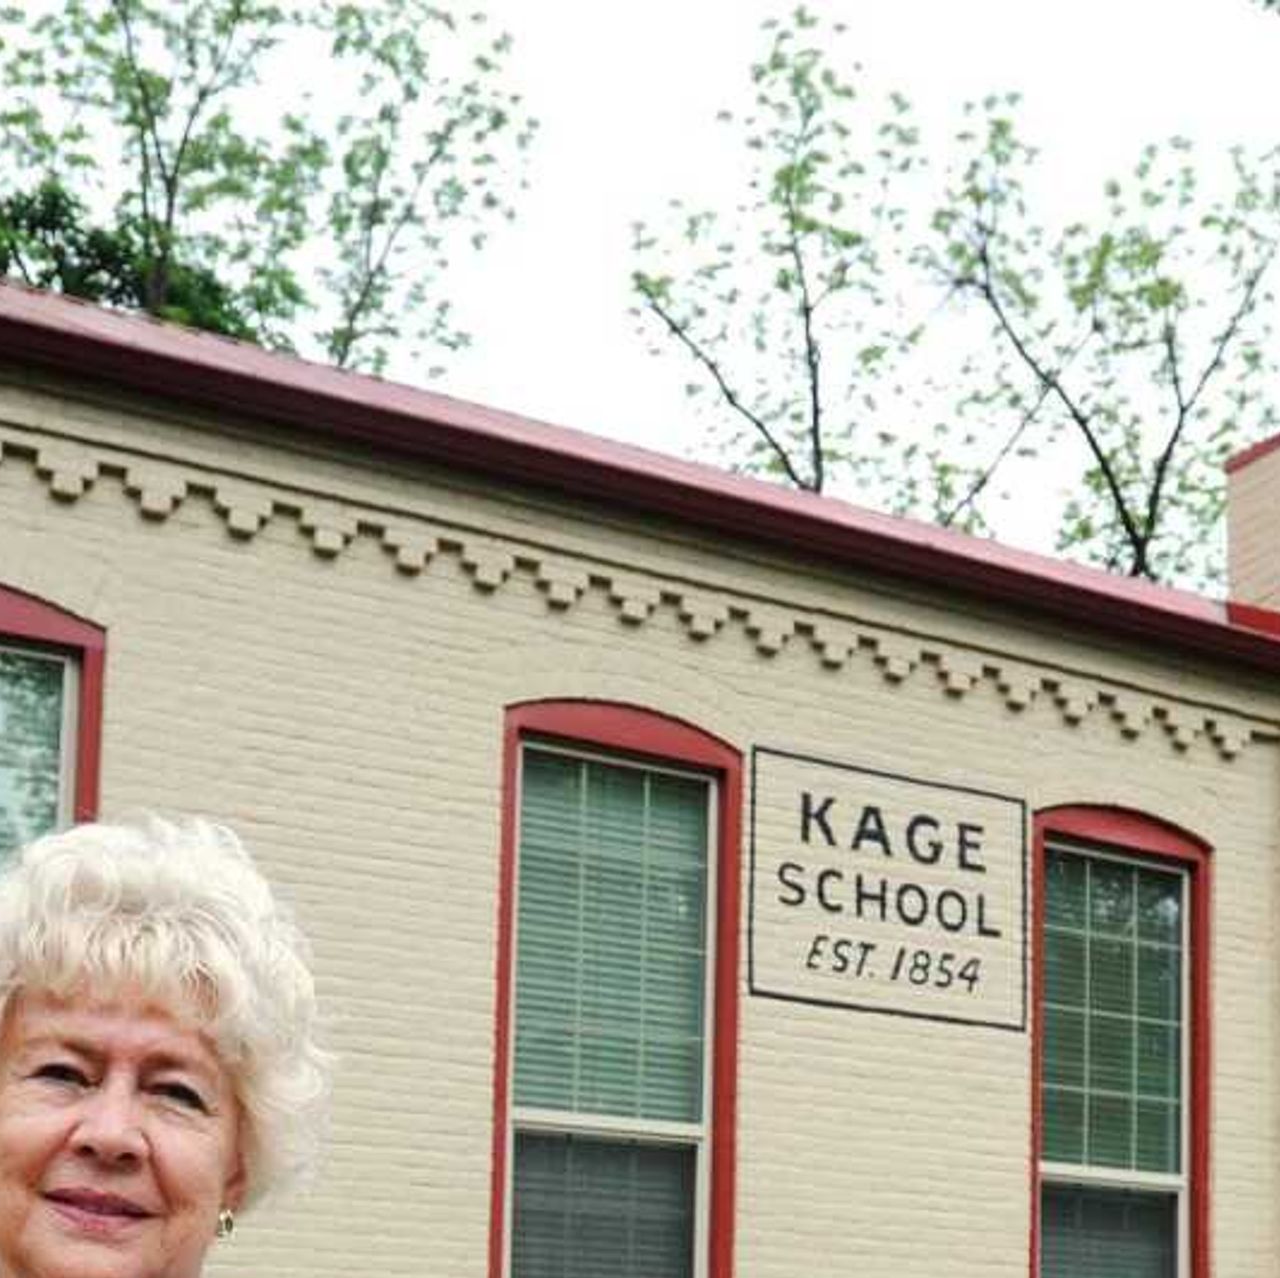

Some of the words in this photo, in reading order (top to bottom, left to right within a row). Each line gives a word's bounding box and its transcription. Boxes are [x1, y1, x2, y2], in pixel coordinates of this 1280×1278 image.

[800, 792, 986, 873] KAGE
[777, 862, 1002, 938] SCHOOL
[805, 935, 876, 978] EST.
[890, 947, 981, 992] 1854
